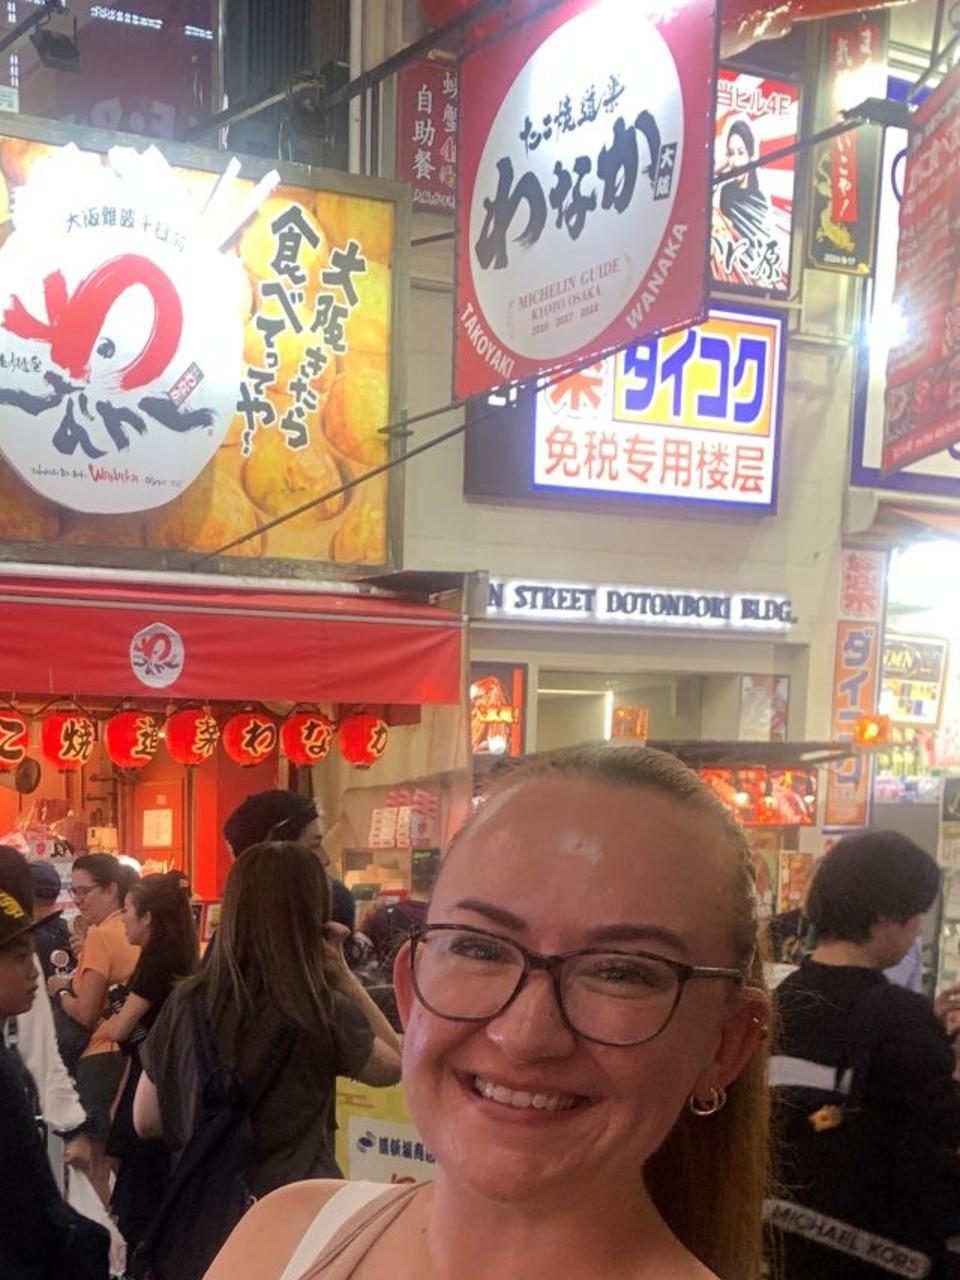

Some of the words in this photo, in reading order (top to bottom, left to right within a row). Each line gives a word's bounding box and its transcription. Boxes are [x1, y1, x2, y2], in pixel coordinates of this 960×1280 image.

[412, 84, 436, 180] 自助餐
[475, 110, 662, 270] わなか
[519, 278, 577, 312] MICHELIN
[580, 257, 622, 286] GUIDE
[626, 223, 688, 329] WANAKA
[460, 302, 516, 379] TAKOYAKI
[544, 426, 765, 493] 免税专用楼层
[514, 585, 597, 612] STREET
[606, 590, 731, 619] DOTONBORI
